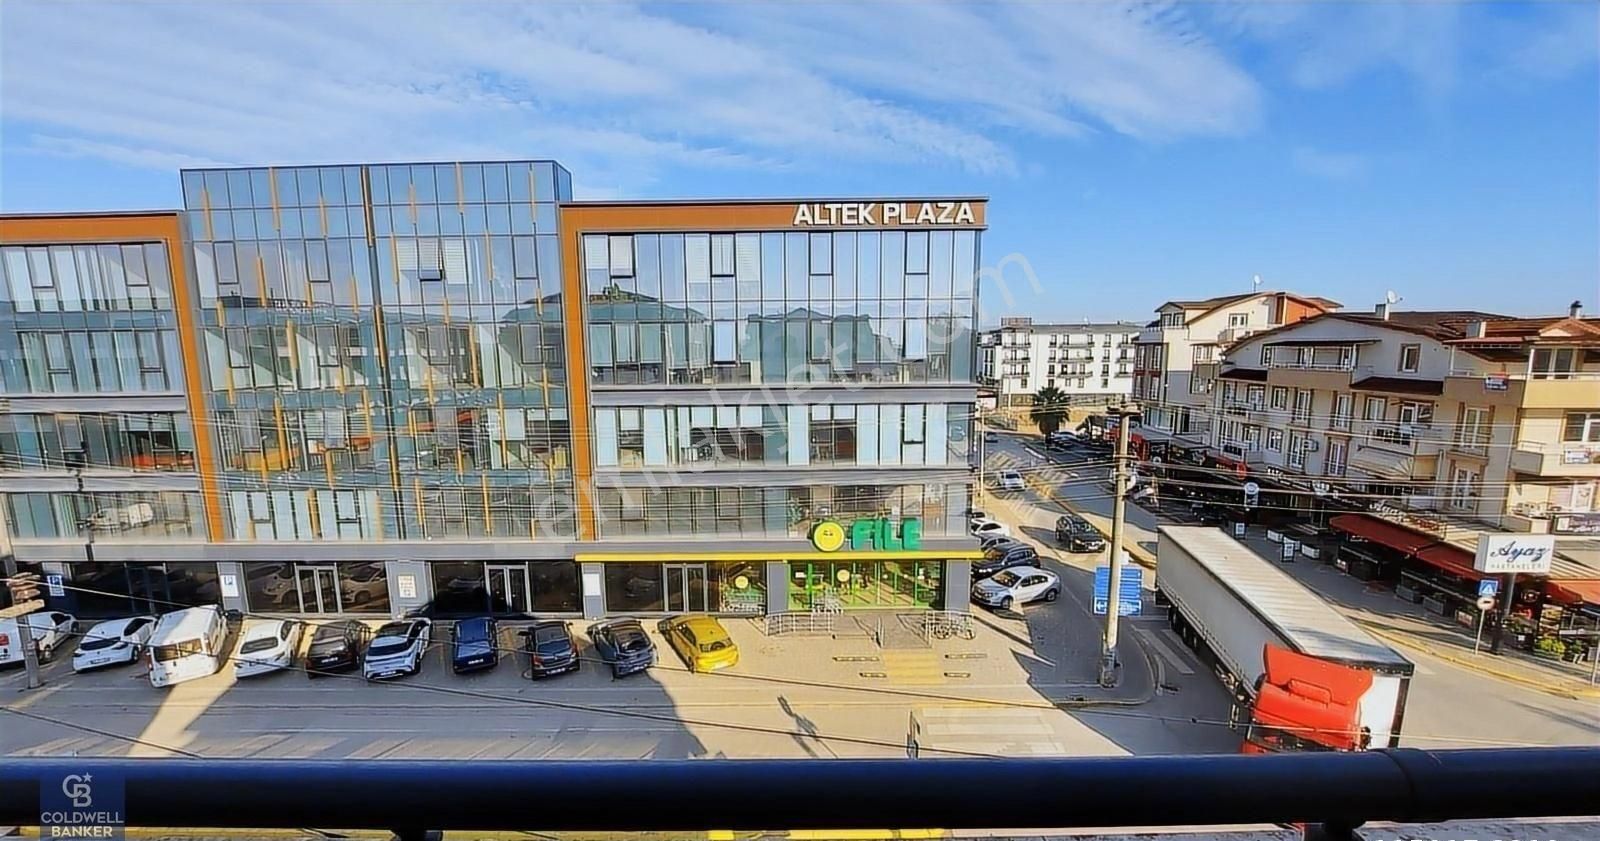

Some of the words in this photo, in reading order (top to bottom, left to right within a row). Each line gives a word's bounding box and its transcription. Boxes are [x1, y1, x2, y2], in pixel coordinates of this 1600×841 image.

[793, 203, 876, 225] ALTEK
[882, 202, 975, 224] PLAZA
[1490, 541, 1550, 563] Ayaz
